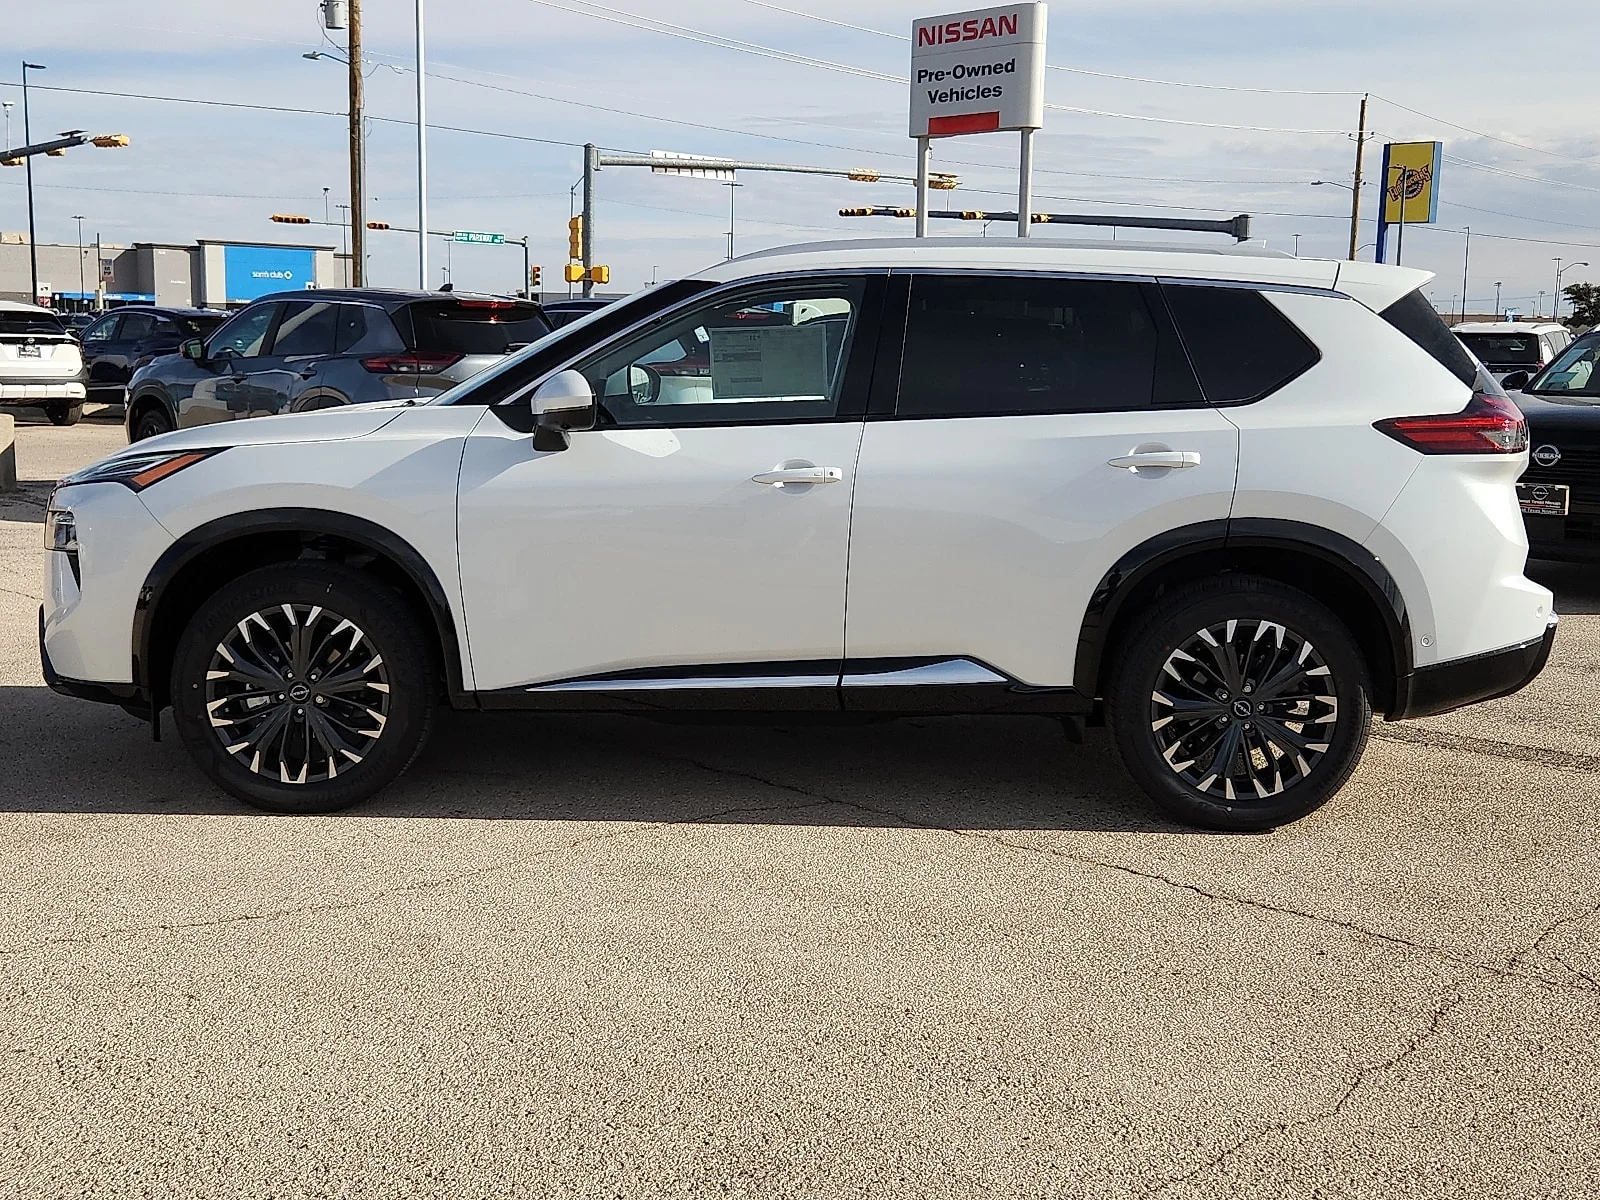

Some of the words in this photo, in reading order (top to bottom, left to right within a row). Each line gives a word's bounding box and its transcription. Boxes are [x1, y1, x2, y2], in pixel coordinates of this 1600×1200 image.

[918, 13, 1018, 48] NISSAN
[917, 58, 1016, 84] Pre-Owned
[927, 84, 1003, 104] Vehicles
[270, 270, 284, 279] club
